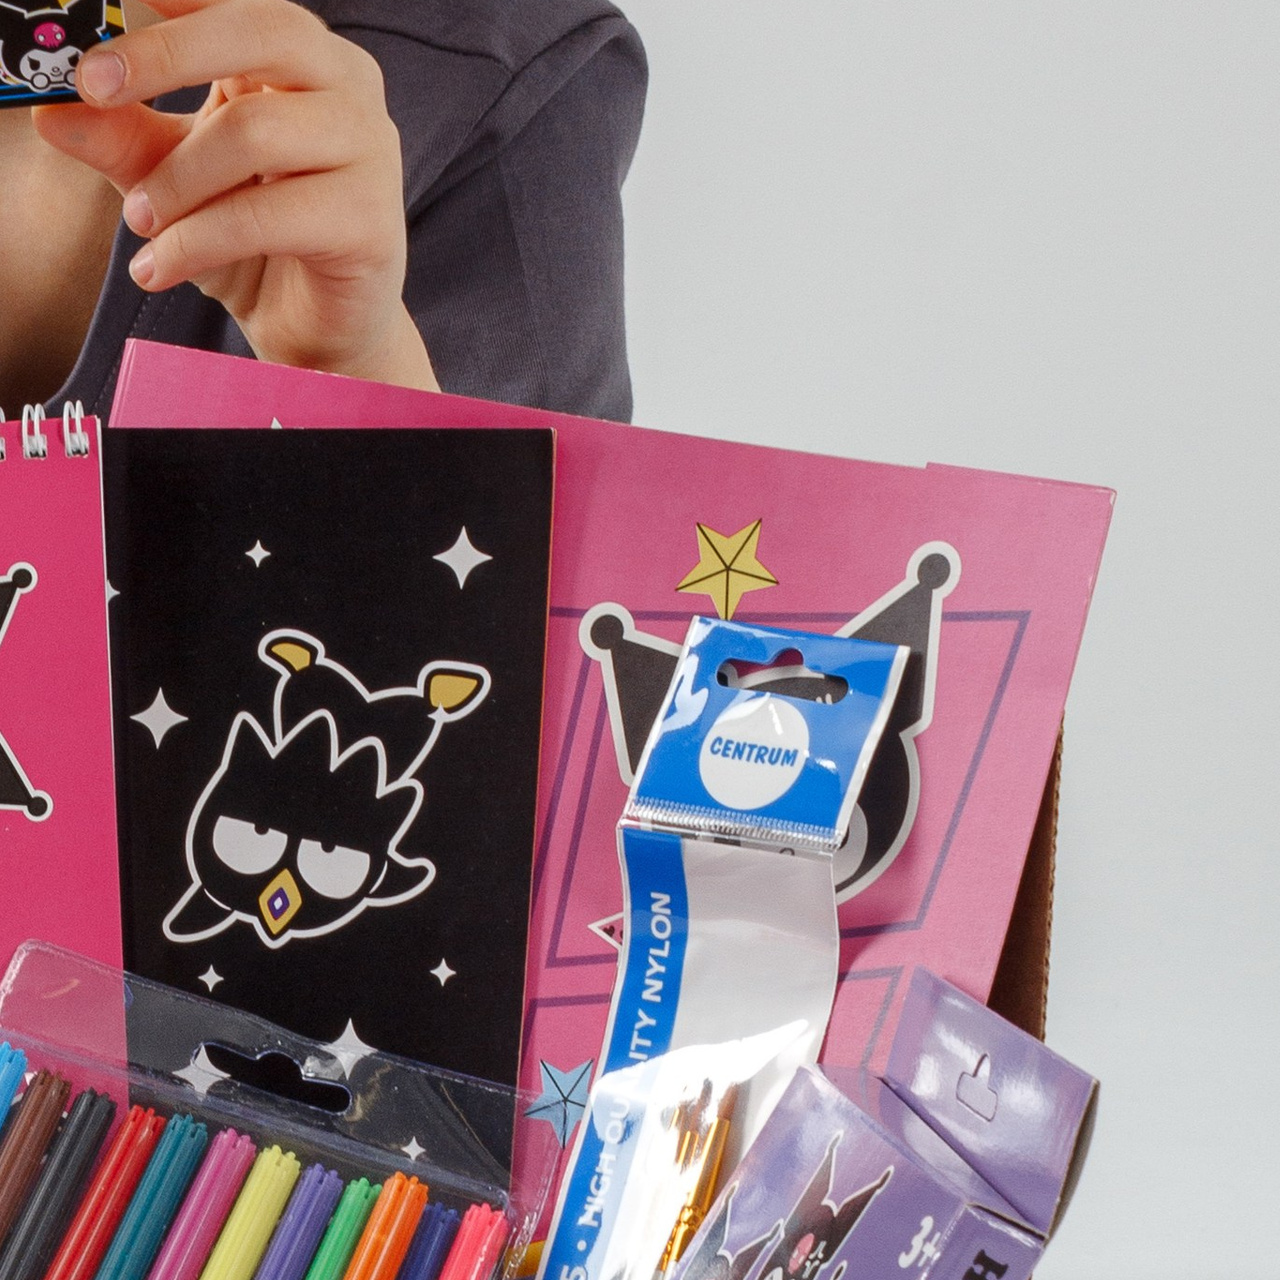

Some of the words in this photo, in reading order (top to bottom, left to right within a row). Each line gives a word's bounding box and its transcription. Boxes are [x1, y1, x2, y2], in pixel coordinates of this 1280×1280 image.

[710, 736, 798, 768] CENTRUM
[577, 1149, 620, 1227] HIGH
[642, 891, 672, 1003] NYLON
[898, 1214, 943, 1270] 3+
